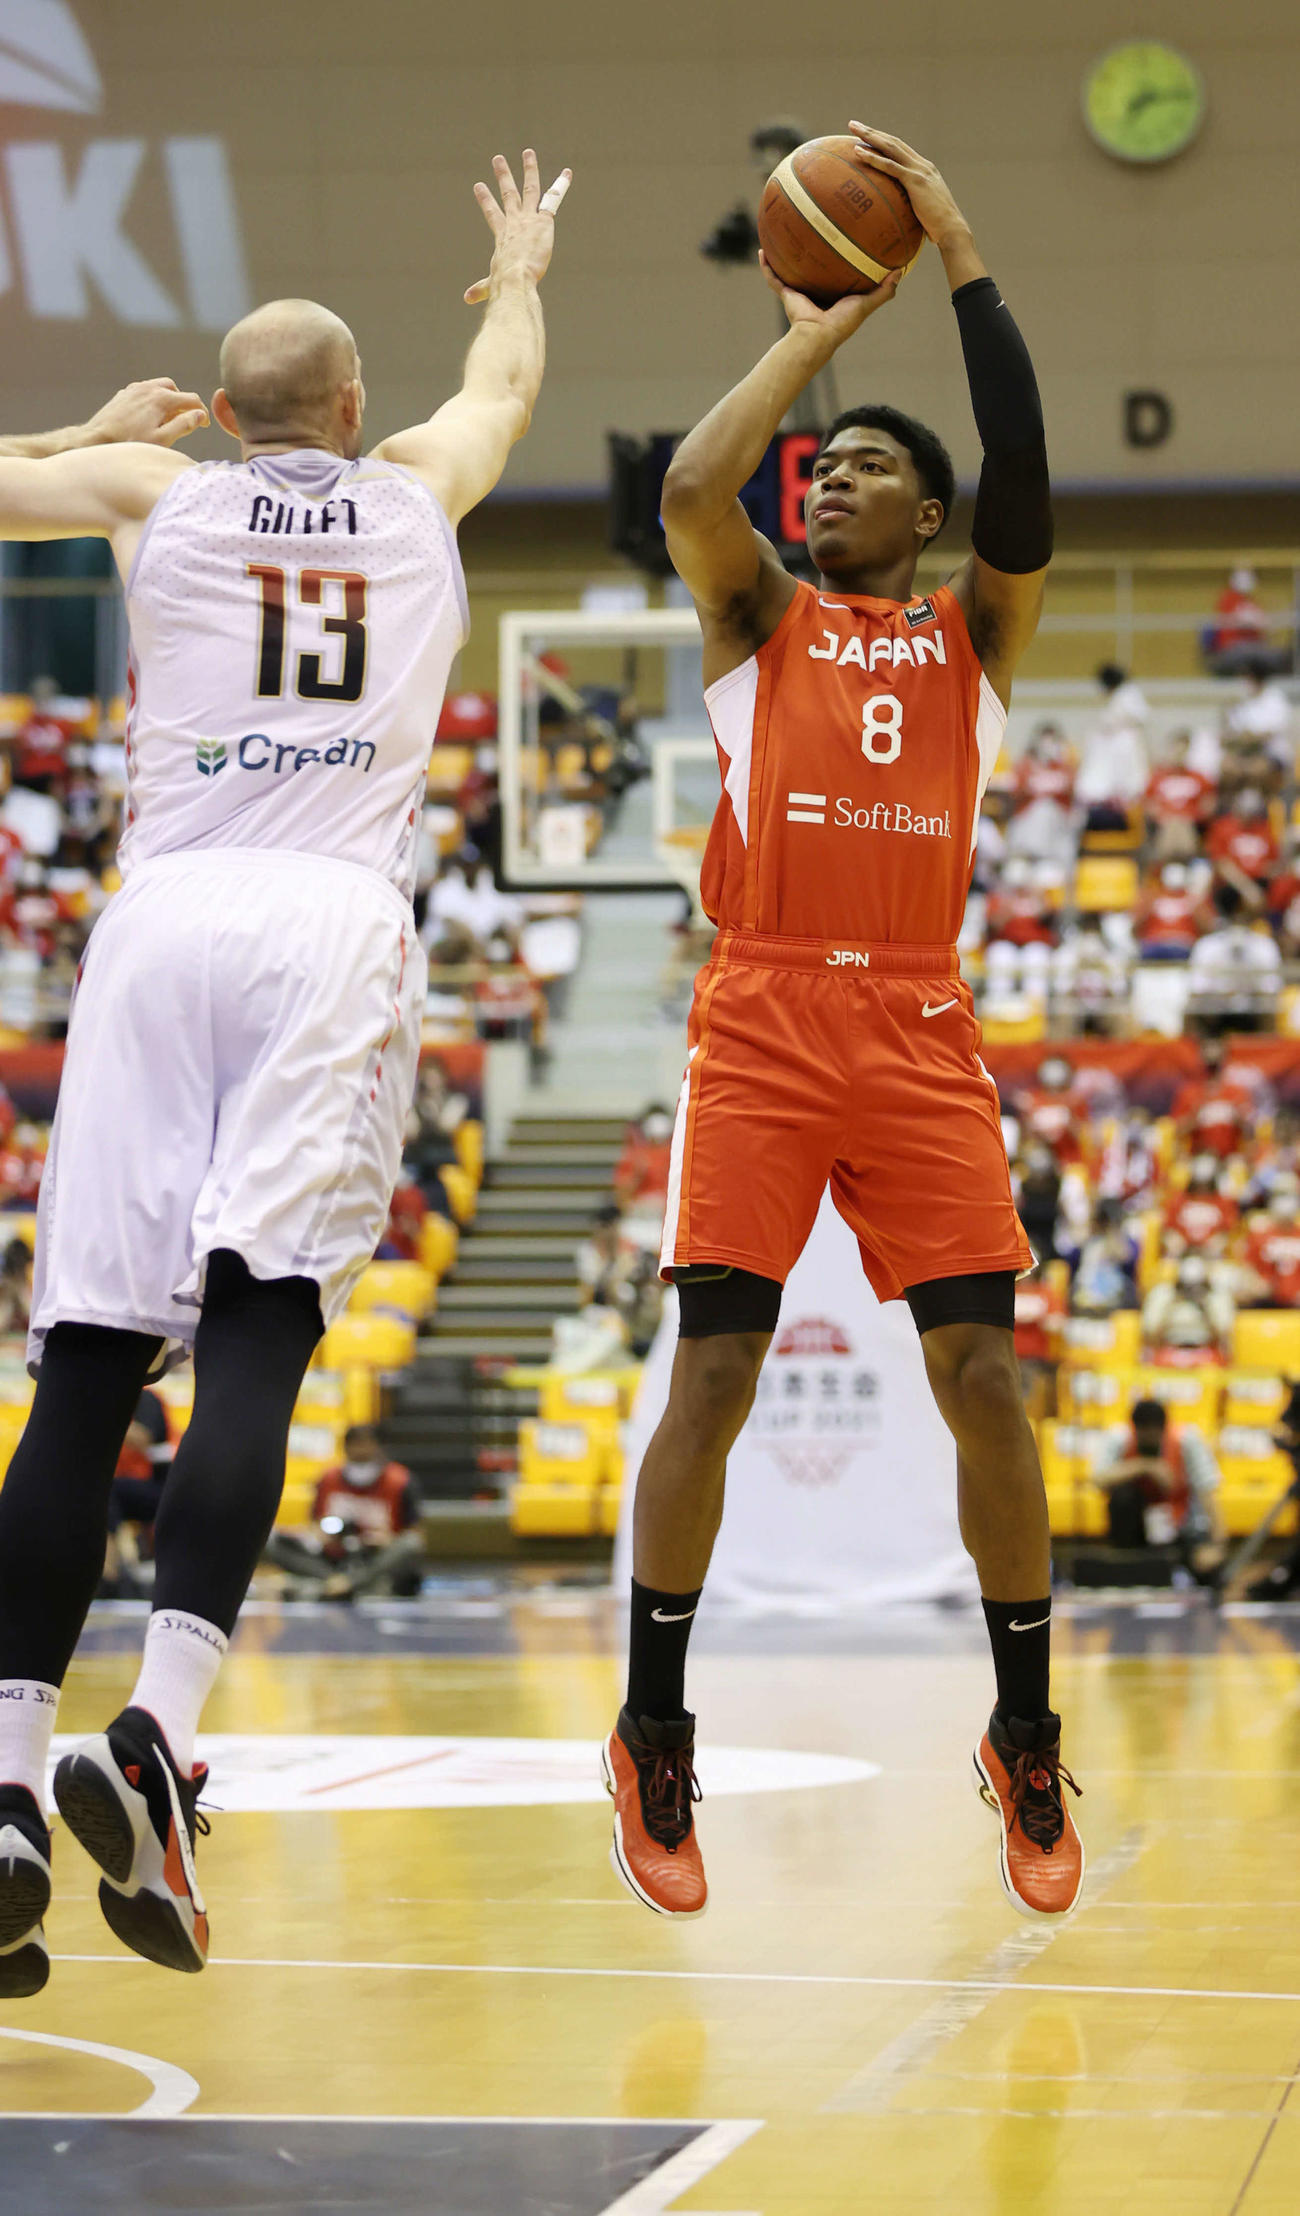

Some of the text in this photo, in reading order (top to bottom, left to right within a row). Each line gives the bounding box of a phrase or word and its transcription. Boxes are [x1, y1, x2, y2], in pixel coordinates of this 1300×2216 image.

[840, 179, 873, 213] FIBA
[1122, 390, 1172, 450] D
[246, 562, 369, 705] 13
[807, 628, 947, 673] JAPAN
[861, 694, 903, 765] 8
[239, 733, 376, 773] Crean
[826, 950, 869, 968] JPN
